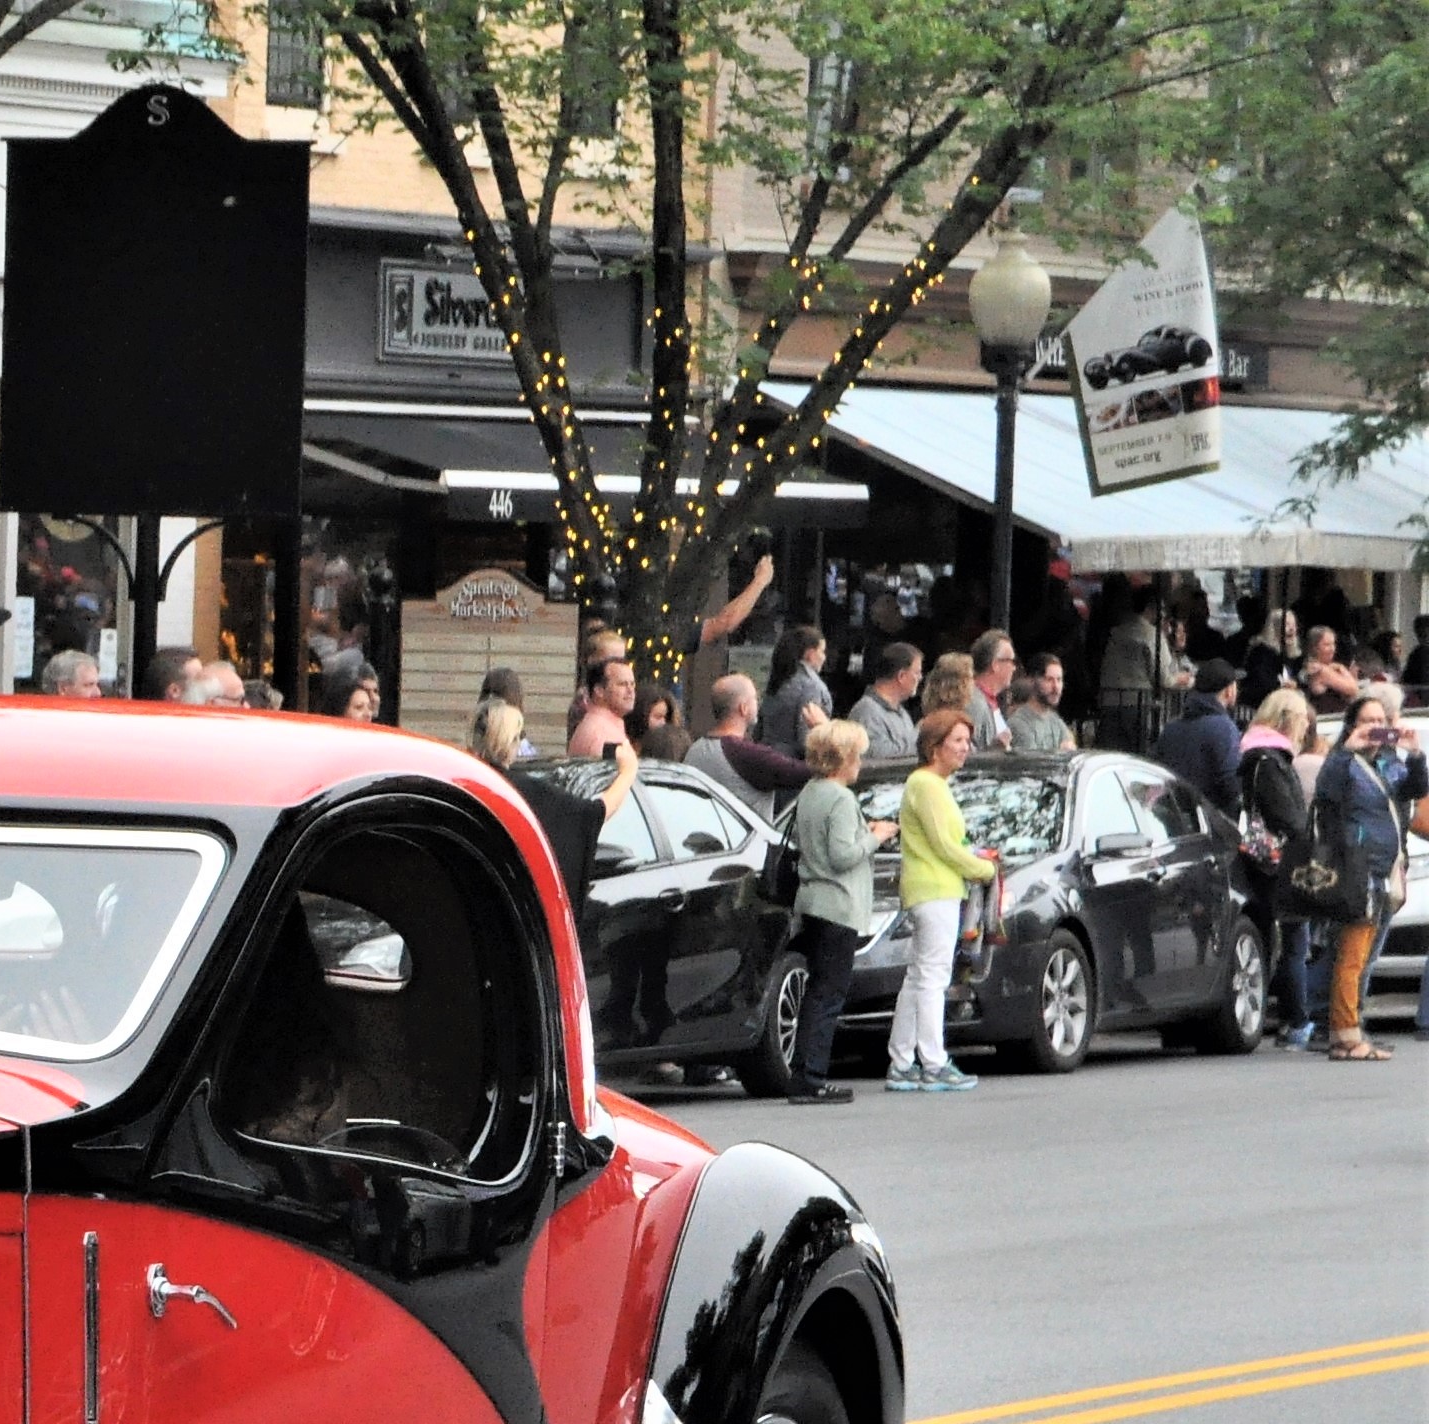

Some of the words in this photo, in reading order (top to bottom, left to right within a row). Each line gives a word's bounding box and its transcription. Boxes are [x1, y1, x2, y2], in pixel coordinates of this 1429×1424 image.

[147, 95, 170, 126] S
[1228, 349, 1250, 378] Bar
[489, 489, 513, 519] 446
